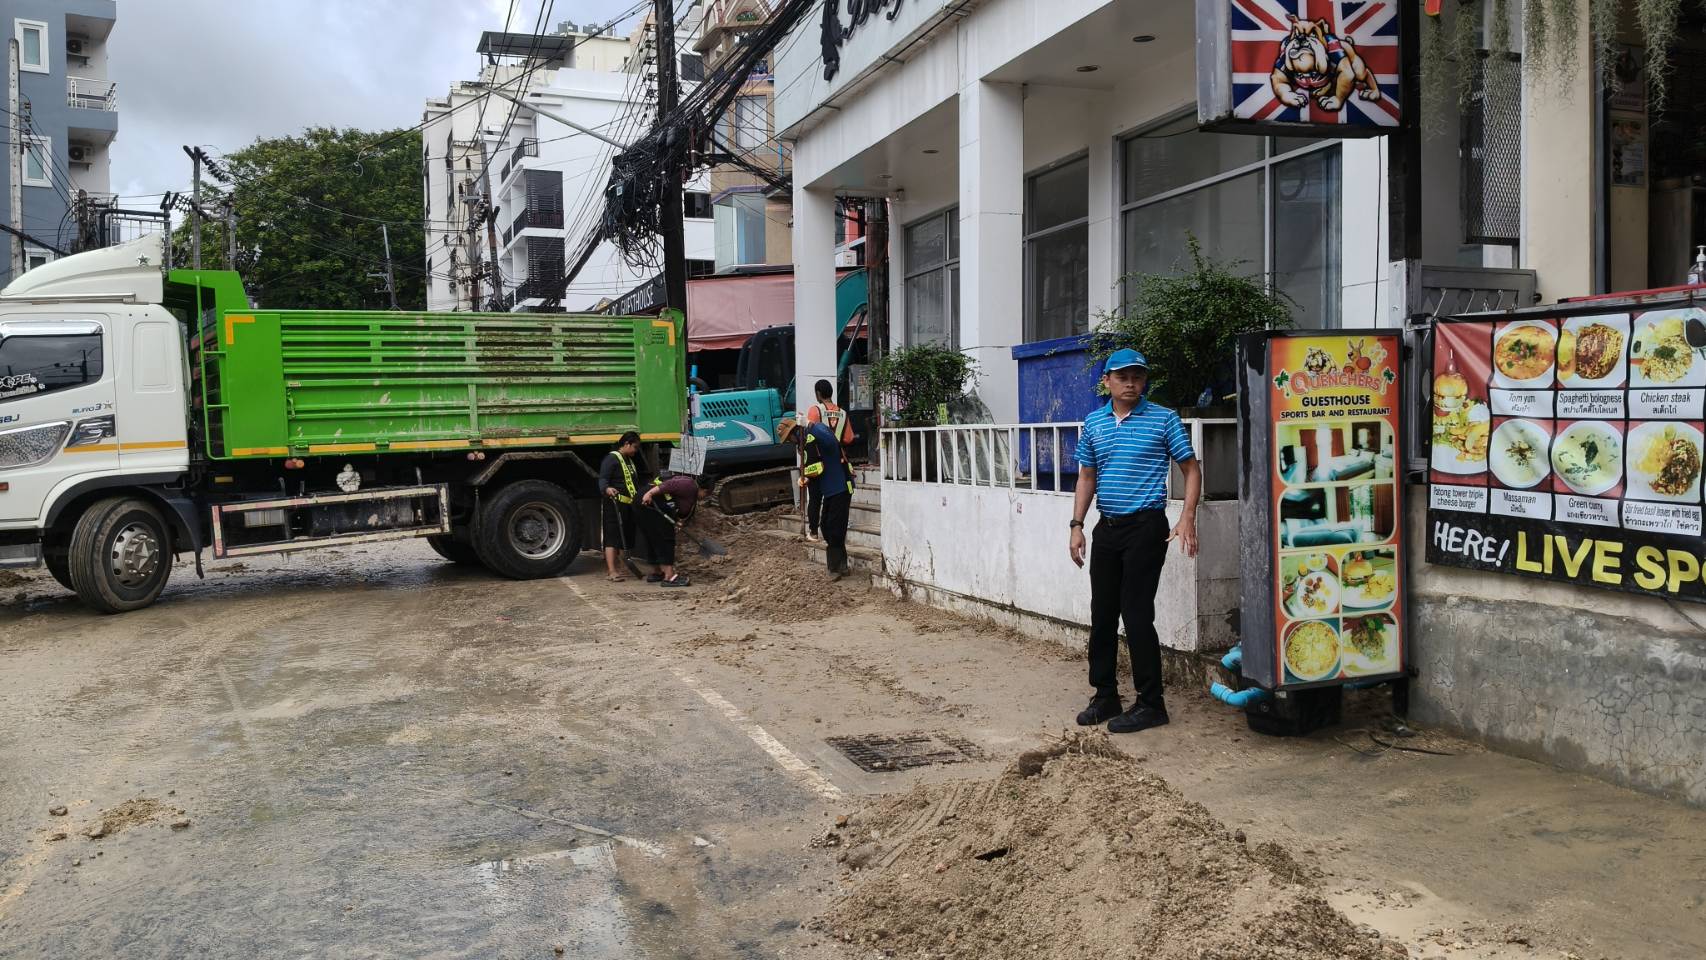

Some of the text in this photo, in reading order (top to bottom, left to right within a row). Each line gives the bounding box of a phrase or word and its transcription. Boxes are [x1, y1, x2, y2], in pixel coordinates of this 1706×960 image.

[1290, 370, 1381, 395] QUENCHERS
[1301, 395, 1371, 407] GUESTHOUSE
[1508, 393, 1535, 403] Tom yum
[1559, 392, 1622, 404] Spaghetti bolognese
[1640, 392, 1691, 403] Chicken steak
[1281, 410, 1308, 418] SPORTS
[1328, 409, 1344, 417] AND
[1347, 407, 1390, 416] RESTAURANT
[1452, 488, 1467, 498] tower
[1468, 489, 1484, 500] triple
[1503, 491, 1537, 504] Massaman
[1437, 496, 1476, 509] cheese burger
[1568, 498, 1603, 513] Green curry
[1671, 507, 1681, 517] with
[1681, 508, 1692, 518] fried
[1433, 520, 1706, 593] HERE! LIVE SP
